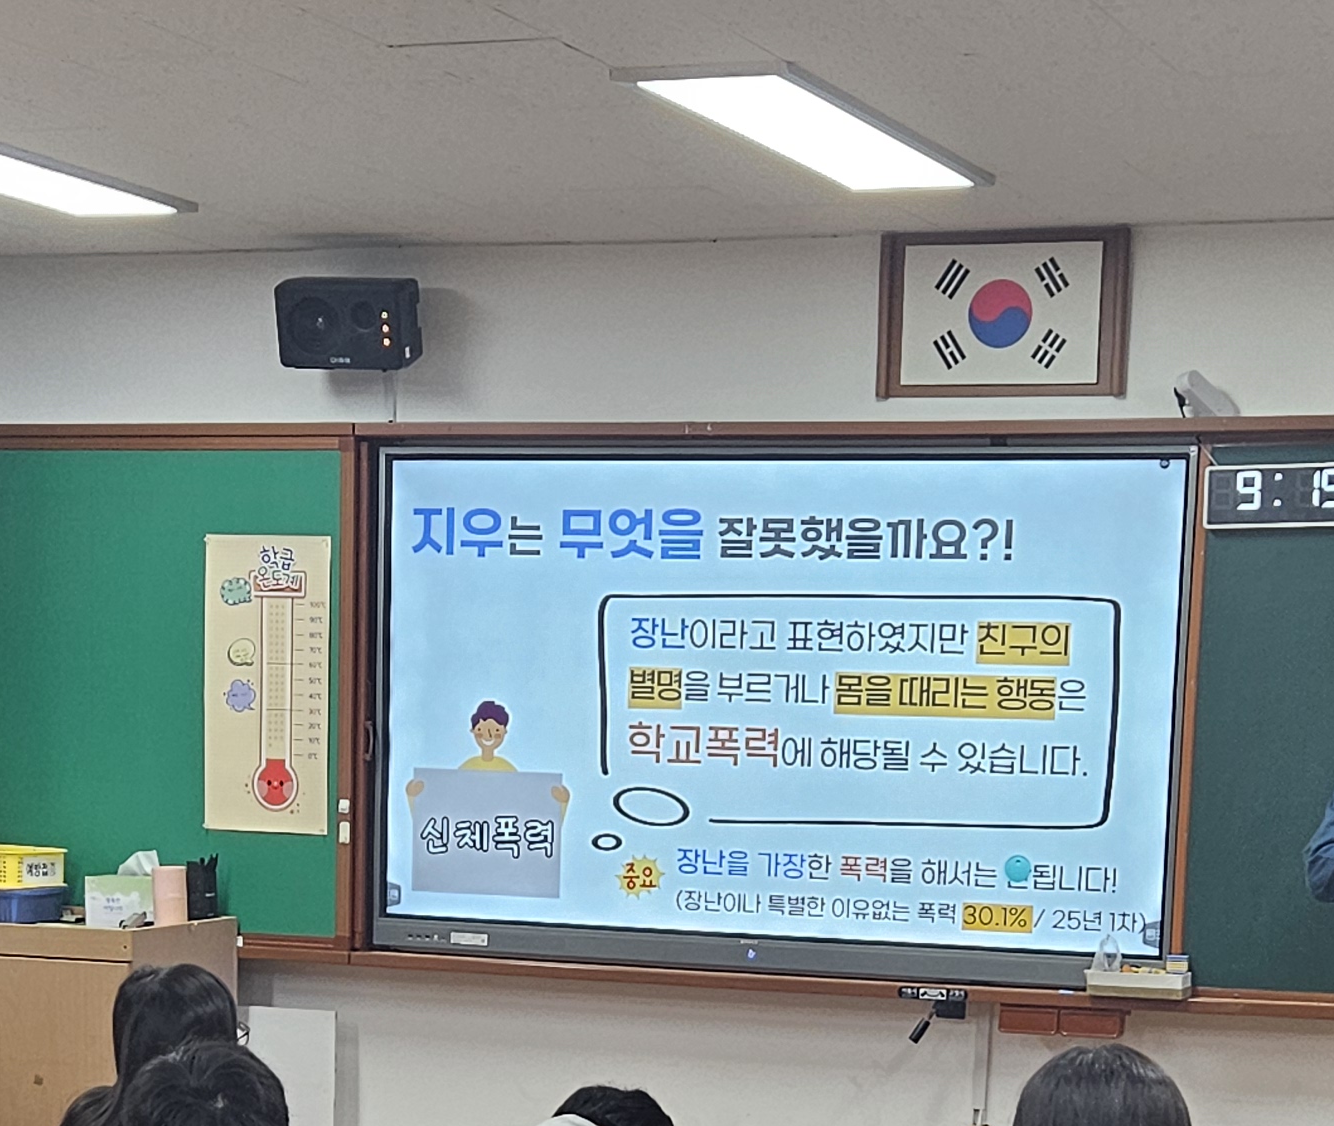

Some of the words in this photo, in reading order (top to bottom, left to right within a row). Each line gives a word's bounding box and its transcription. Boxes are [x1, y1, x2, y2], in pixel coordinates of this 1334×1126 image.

[411, 506, 544, 558] 지우는
[559, 508, 704, 560] 무엇을
[717, 515, 1014, 561] 잘못했을까요?!
[257, 566, 299, 588] 온도계
[259, 545, 296, 571] 학급
[630, 617, 777, 651] 장난이라고
[786, 619, 969, 654] 표현하였지만
[978, 622, 1070, 656] 친구의
[630, 669, 710, 702] 별명을
[717, 671, 830, 704] 부르거나
[835, 674, 893, 707] 몸을
[898, 676, 989, 709] 때리는
[996, 676, 1087, 712] 행동은
[628, 721, 812, 768] 학교폭력에
[820, 737, 910, 772] 해당될
[919, 741, 948, 773] 수
[958, 742, 1088, 777] 있습니다.
[420, 815, 555, 859] 신체폭력
[622, 861, 657, 890] 중요
[676, 848, 749, 877] 장난을
[758, 852, 832, 881] 가장한
[839, 855, 913, 885] 폭력을
[921, 858, 998, 888] 해서는
[1006, 863, 1117, 894] 됩니다!
[676, 889, 761, 914] (장난이나
[768, 894, 826, 918] 특별한
[831, 897, 910, 923] 이유없는
[917, 901, 956, 925] 폭력
[963, 905, 1028, 928] 30.1%
[1052, 909, 1102, 932] 25년
[1109, 911, 1147, 935] 1차)
